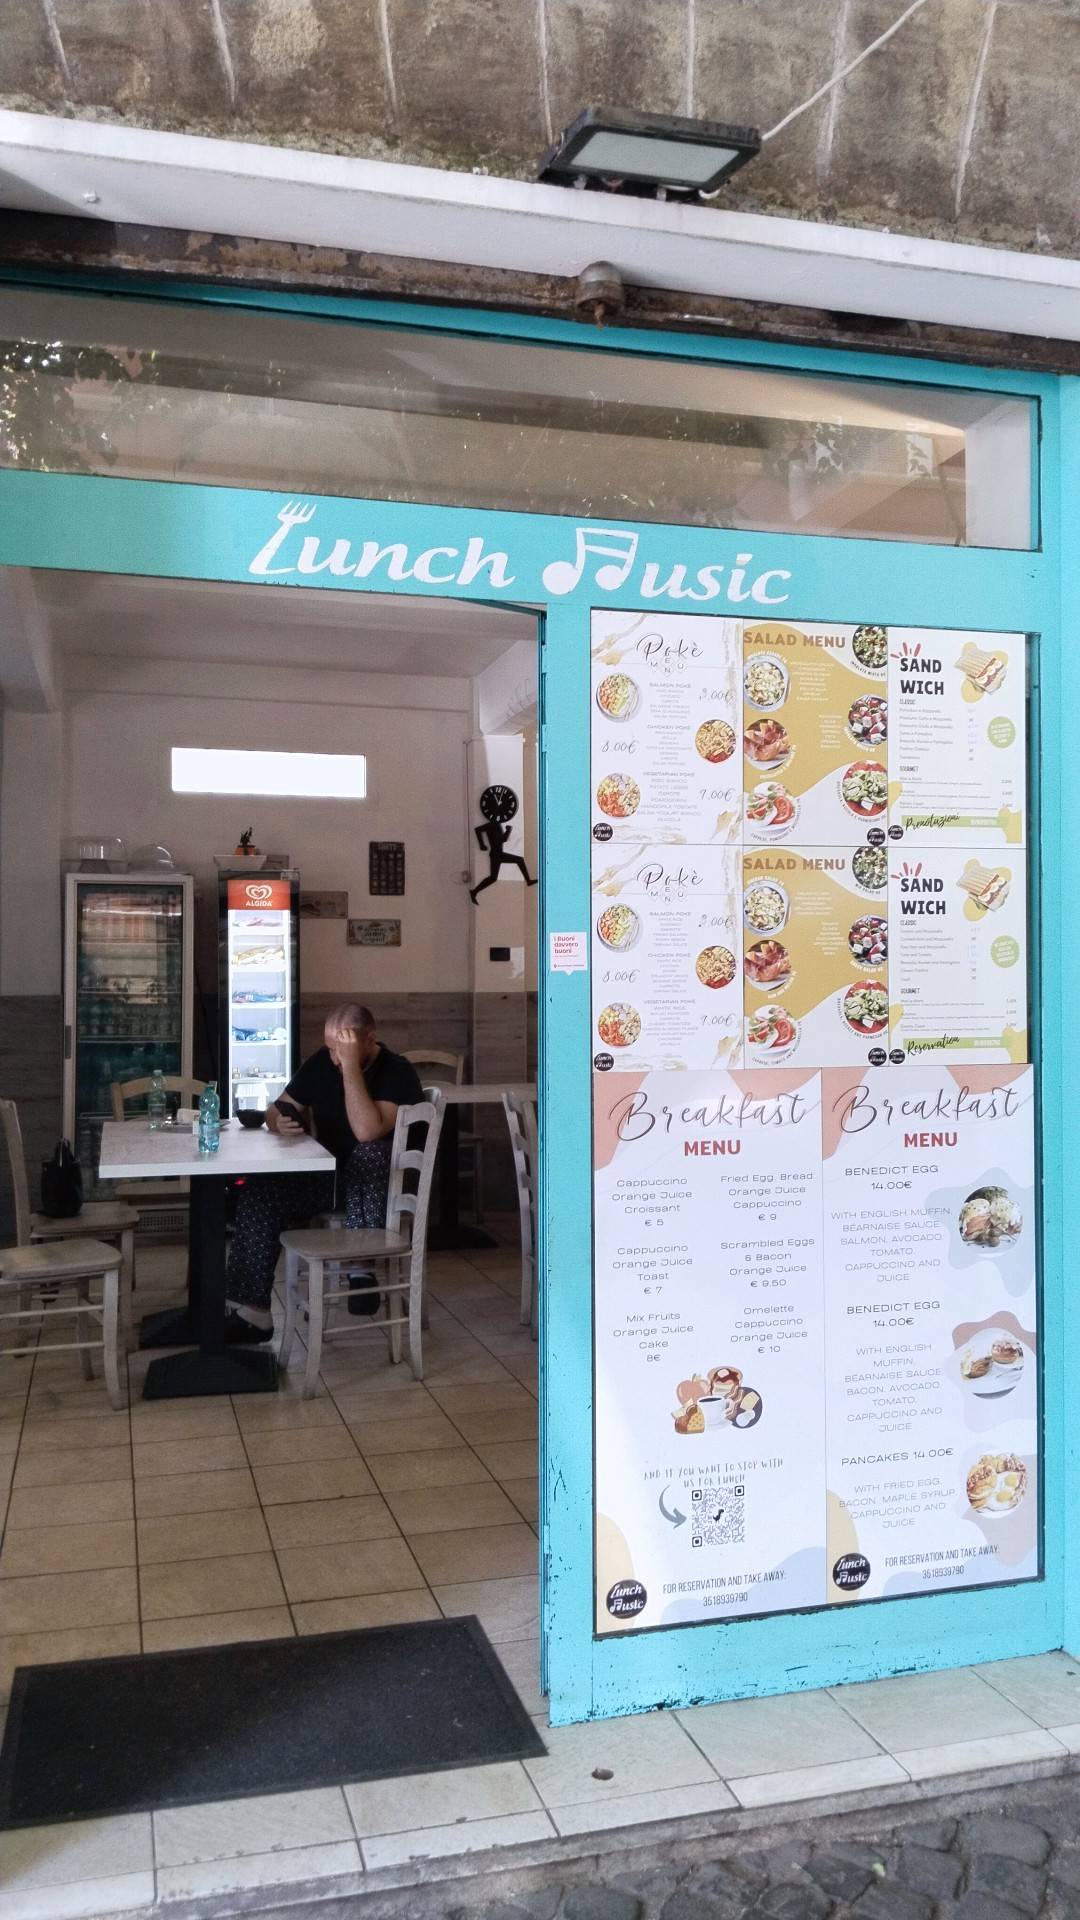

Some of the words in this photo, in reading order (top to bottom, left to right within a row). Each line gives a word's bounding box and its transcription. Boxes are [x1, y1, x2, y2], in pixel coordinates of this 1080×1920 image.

[248, 500, 517, 588] Lunch
[743, 632, 797, 646] SALAD
[803, 635, 846, 648] MENU
[900, 658, 942, 673] SAND
[900, 680, 944, 695] WICH
[743, 858, 796, 870] SALAD
[803, 858, 846, 870] MENU
[900, 878, 944, 892] SAND
[900, 900, 946, 915] WICH
[832, 1085, 1020, 1134] Breakfast
[608, 1091, 808, 1142] Breakfast
[904, 1132, 958, 1148] MENU
[684, 1139, 741, 1157] MENU
[845, 1166, 909, 1176] BENEDICT
[912, 1165, 939, 1174] EGG
[616, 1177, 688, 1189] Cappuccino
[720, 1175, 749, 1184] Fried
[780, 1172, 813, 1181] Bread
[871, 1180, 913, 1190] 14.00€
[612, 1192, 656, 1202] Orange
[660, 1191, 693, 1199] Juice
[728, 1188, 771, 1198] Orange
[774, 1186, 806, 1194] Juice
[624, 1205, 681, 1214] Croissant
[733, 1199, 802, 1211] Cappuccino
[758, 1213, 766, 1221] €
[769, 1213, 777, 1221] 9
[831, 1211, 857, 1220] WITH
[860, 1209, 908, 1219] ENGLISH
[644, 1219, 653, 1227] €
[842, 1222, 900, 1232] BEARNAISE
[904, 1220, 941, 1230] SAUCE
[720, 1239, 784, 1250] Scrambled
[787, 1238, 815, 1248] Eggs
[617, 1244, 689, 1257] Cappuccino
[755, 1252, 792, 1261] Bacon
[612, 1259, 657, 1270] Orange
[661, 1258, 693, 1267] Juice
[729, 1265, 773, 1276] Orange
[776, 1264, 807, 1273] Juice
[845, 1261, 915, 1271] CAPPUCCINO
[918, 1259, 941, 1268] AND
[638, 1272, 669, 1282] Toast
[876, 1273, 911, 1282] JUICE
[750, 1280, 758, 1288] €
[643, 1287, 652, 1295] €
[656, 1286, 663, 1294] 7
[743, 1305, 795, 1315] Omelette
[847, 1303, 911, 1315] BENEDICT
[914, 1301, 941, 1310] EGG
[626, 1314, 645, 1323] Mix
[648, 1312, 681, 1322] Fruits
[734, 1317, 803, 1330] Cappuccino
[873, 1317, 915, 1328] 14.00€
[613, 1327, 658, 1338] Orange
[661, 1325, 694, 1335] Juice
[730, 1332, 774, 1343] Orange
[776, 1331, 808, 1340] Juice
[639, 1340, 669, 1349] Cake
[757, 1346, 766, 1354] €
[769, 1345, 781, 1353] 10
[856, 1347, 882, 1356] WITH
[885, 1344, 932, 1354] ENGLISH
[844, 1371, 903, 1383] BEARNAISE
[905, 1368, 942, 1378] SAUCE
[847, 1409, 918, 1422] CAPPUCCINO
[920, 1406, 943, 1416] AND
[879, 1422, 913, 1432] JUICE
[841, 1452, 909, 1467] PANCAKES
[913, 1447, 954, 1460] 14.00€
[643, 1470, 661, 1481] AND
[678, 1467, 695, 1477] YOU
[698, 1464, 721, 1475] WANT
[761, 1458, 784, 1469] WITH
[854, 1484, 880, 1494] WITH
[884, 1481, 914, 1490] FRIED
[882, 1493, 917, 1503] MAPLE
[850, 1505, 921, 1520] CAPPUCCINO
[924, 1502, 946, 1511] AND
[882, 1518, 916, 1528] JUICE
[884, 1557, 899, 1567] FOR
[899, 1552, 943, 1566] RESERVATION
[944, 1548, 959, 1560] AND
[960, 1546, 977, 1558] TAKE
[836, 1557, 866, 1571] Lunch
[663, 1583, 677, 1594] FOR
[678, 1578, 726, 1593] RESERVATION
[728, 1575, 743, 1586] AND
[744, 1573, 762, 1584] TAKE
[611, 1583, 642, 1598] Lunch
